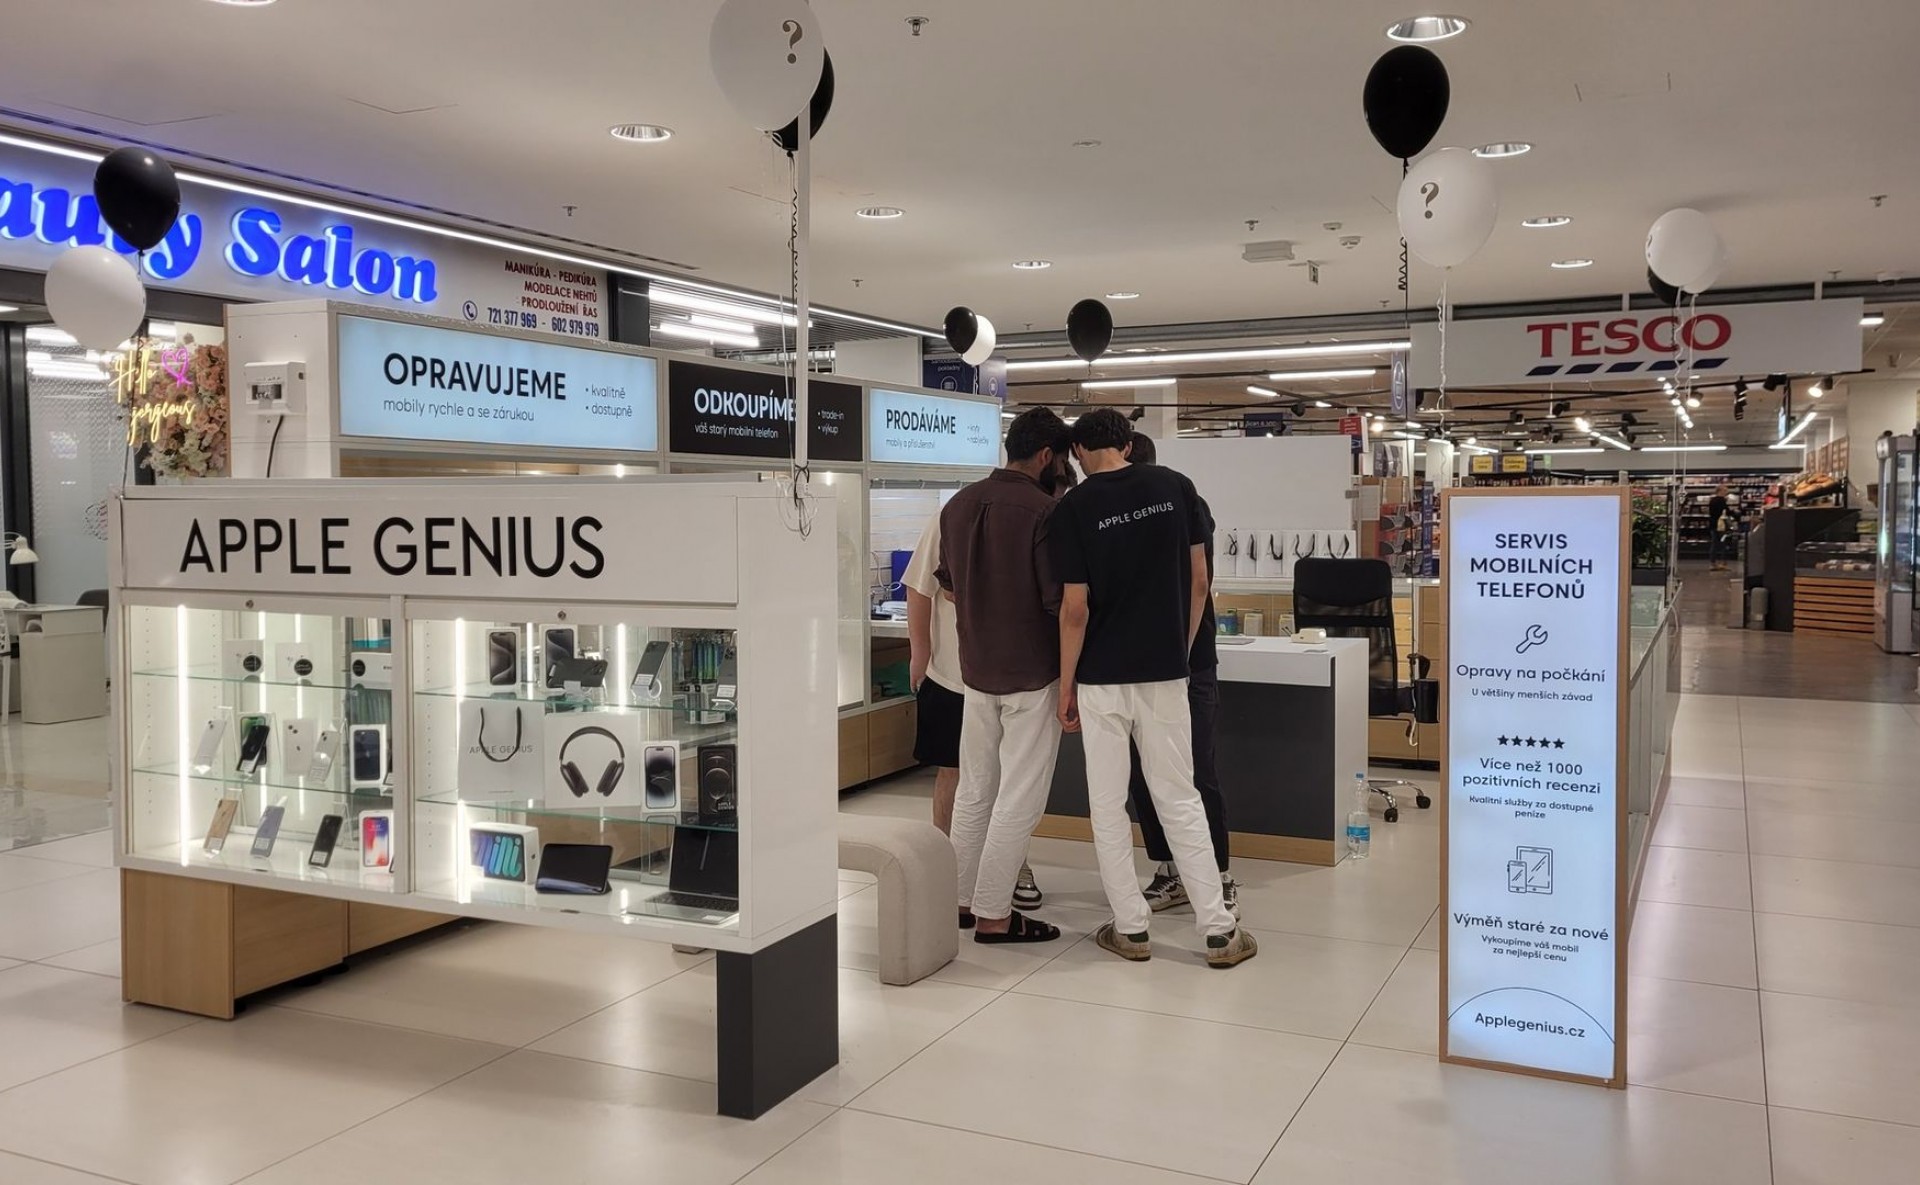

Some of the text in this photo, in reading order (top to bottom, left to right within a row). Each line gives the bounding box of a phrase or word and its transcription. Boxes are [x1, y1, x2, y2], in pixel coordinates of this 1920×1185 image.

[225, 207, 438, 303] Salon
[504, 260, 551, 279] MANIKÚRA
[558, 271, 597, 287] PEDIKÚRA
[524, 280, 571, 298] MODELACE
[521, 296, 598, 318] PRODLOUŽENÍ ŘAS
[487, 307, 502, 325] 721
[504, 309, 519, 327] 377
[520, 312, 537, 329] 969
[551, 316, 568, 333] 602
[569, 319, 583, 336] 979
[584, 323, 600, 338] 979
[1526, 312, 1732, 358] TESCO
[383, 352, 567, 401] OPRAVUJEME
[591, 384, 626, 399] kvalitně
[383, 399, 534, 421] mobily rychle a se zárukou
[591, 402, 633, 419] dostupně
[693, 388, 795, 422] ODKOUPÍME
[886, 406, 957, 435] PRODÁVÁME
[755, 427, 779, 439] telefon
[1098, 501, 1175, 531] APPLE GENIUS
[179, 516, 606, 580] APPLE GENIUS
[1495, 533, 1568, 549] SERVIS
[1470, 553, 1593, 574] MOBILNÍCH
[1476, 578, 1585, 599] TELEFONŮ
[1456, 664, 1606, 682] Opravy na počkání
[1471, 688, 1593, 702] U většiny menších závad
[469, 746, 497, 754] APLE
[1480, 757, 1583, 776] Více než 1000
[1462, 773, 1602, 794] pozitivních recenzi
[1505, 797, 1532, 808] služby
[1549, 801, 1594, 813] dostupné
[1453, 912, 1609, 941] Výměň staré za nové
[1481, 935, 1579, 952] Vykoupíme váš mobil
[1506, 947, 1542, 959] nejlepší
[1543, 953, 1567, 962] cenu
[1474, 1012, 1586, 1038] Applegenius.cz
